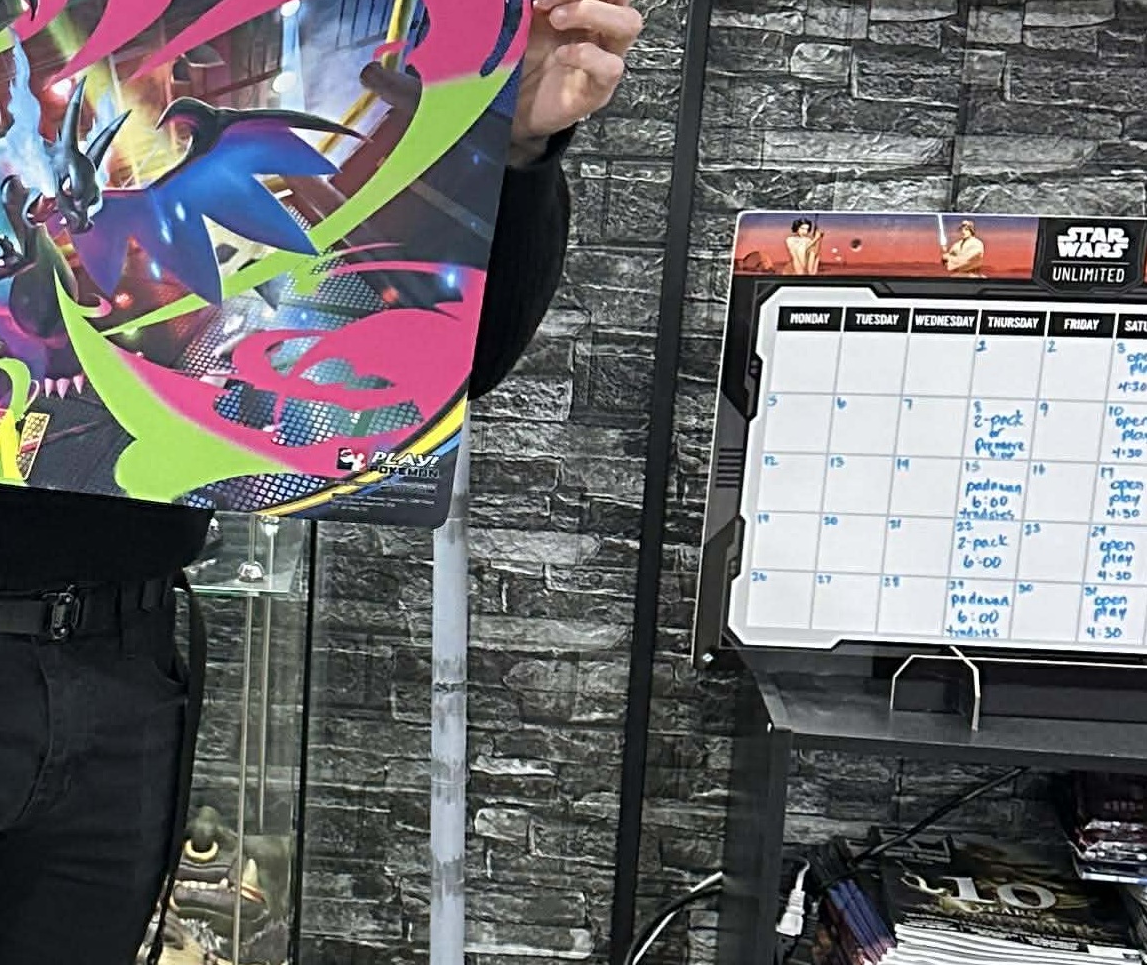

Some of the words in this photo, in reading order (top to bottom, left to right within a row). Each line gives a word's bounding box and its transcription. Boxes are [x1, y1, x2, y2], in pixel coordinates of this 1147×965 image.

[1056, 226, 1130, 243] STAR
[1056, 241, 1130, 258] WARS
[1052, 266, 1126, 283] UNLIMITED
[789, 313, 831, 325] MONDAY
[855, 313, 900, 326] TUESDAY
[915, 314, 975, 328] WEDNESDAY
[987, 316, 1040, 329] THURSDAY
[1063, 318, 1100, 331] FRIDAY
[1047, 340, 1057, 353] 2
[1116, 342, 1126, 353] 3
[767, 395, 777, 407] 5
[836, 396, 847, 410] 6
[903, 398, 913, 410] 7
[1040, 402, 1049, 417] 9
[1108, 406, 1124, 417] 10
[371, 451, 440, 467] PLAY!
[1111, 448, 1143, 459] 4:30
[1110, 480, 1144, 495] open
[972, 496, 1008, 508] 6:00
[1109, 494, 1141, 506] play
[1106, 508, 1140, 519] 4:30
[958, 534, 1008, 551] 2-pack
[1099, 540, 1135, 555] open
[963, 555, 1002, 568] 6:00
[1102, 553, 1133, 568] play
[1094, 596, 1128, 608] open
[957, 610, 1000, 624] 6:00
[1093, 607, 1128, 621] play
[1086, 627, 1123, 638] 4:30
[942, 876, 1057, 910] 10
